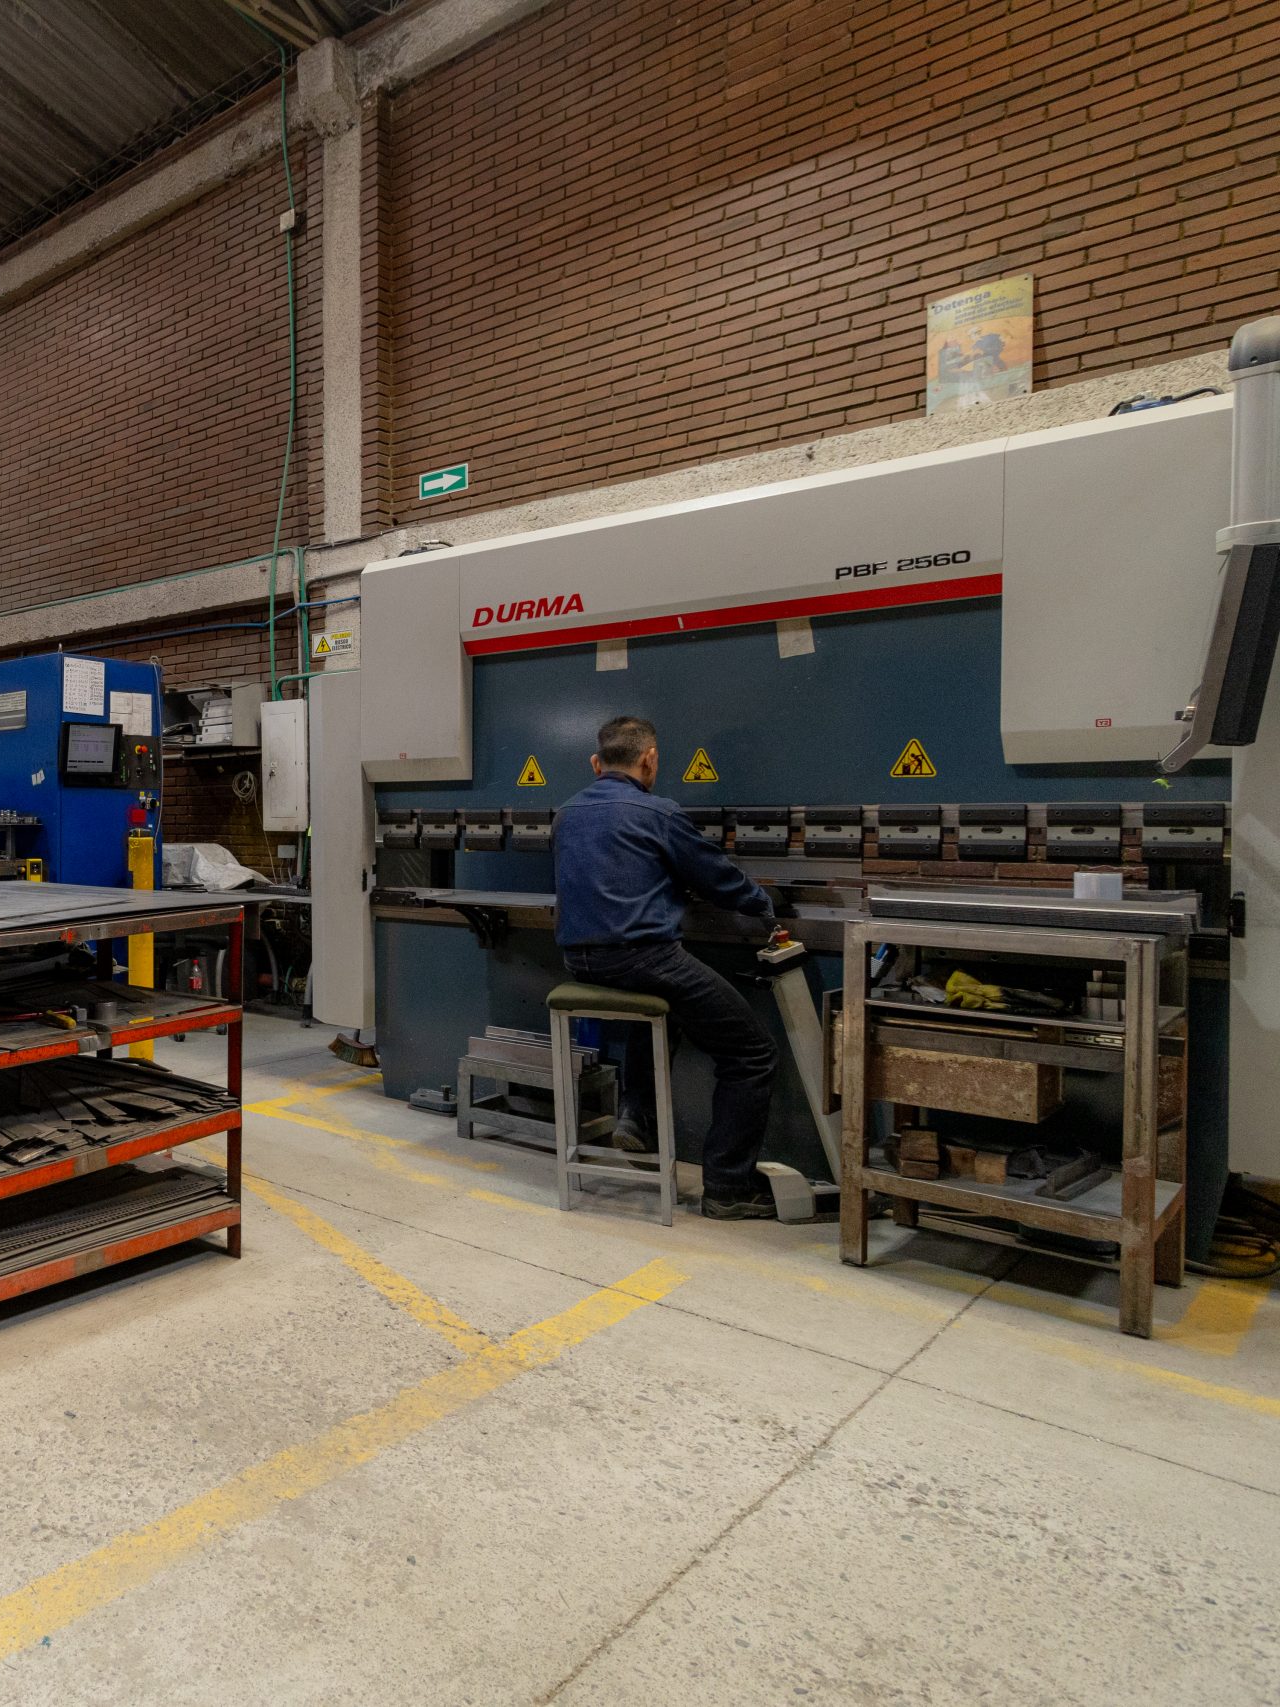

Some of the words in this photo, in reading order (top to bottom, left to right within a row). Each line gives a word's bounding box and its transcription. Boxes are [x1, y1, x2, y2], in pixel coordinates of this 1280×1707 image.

[934, 291, 991, 315] Detenga
[835, 560, 888, 580] PBF
[897, 550, 971, 572] 2560
[472, 593, 584, 627] DURMA
